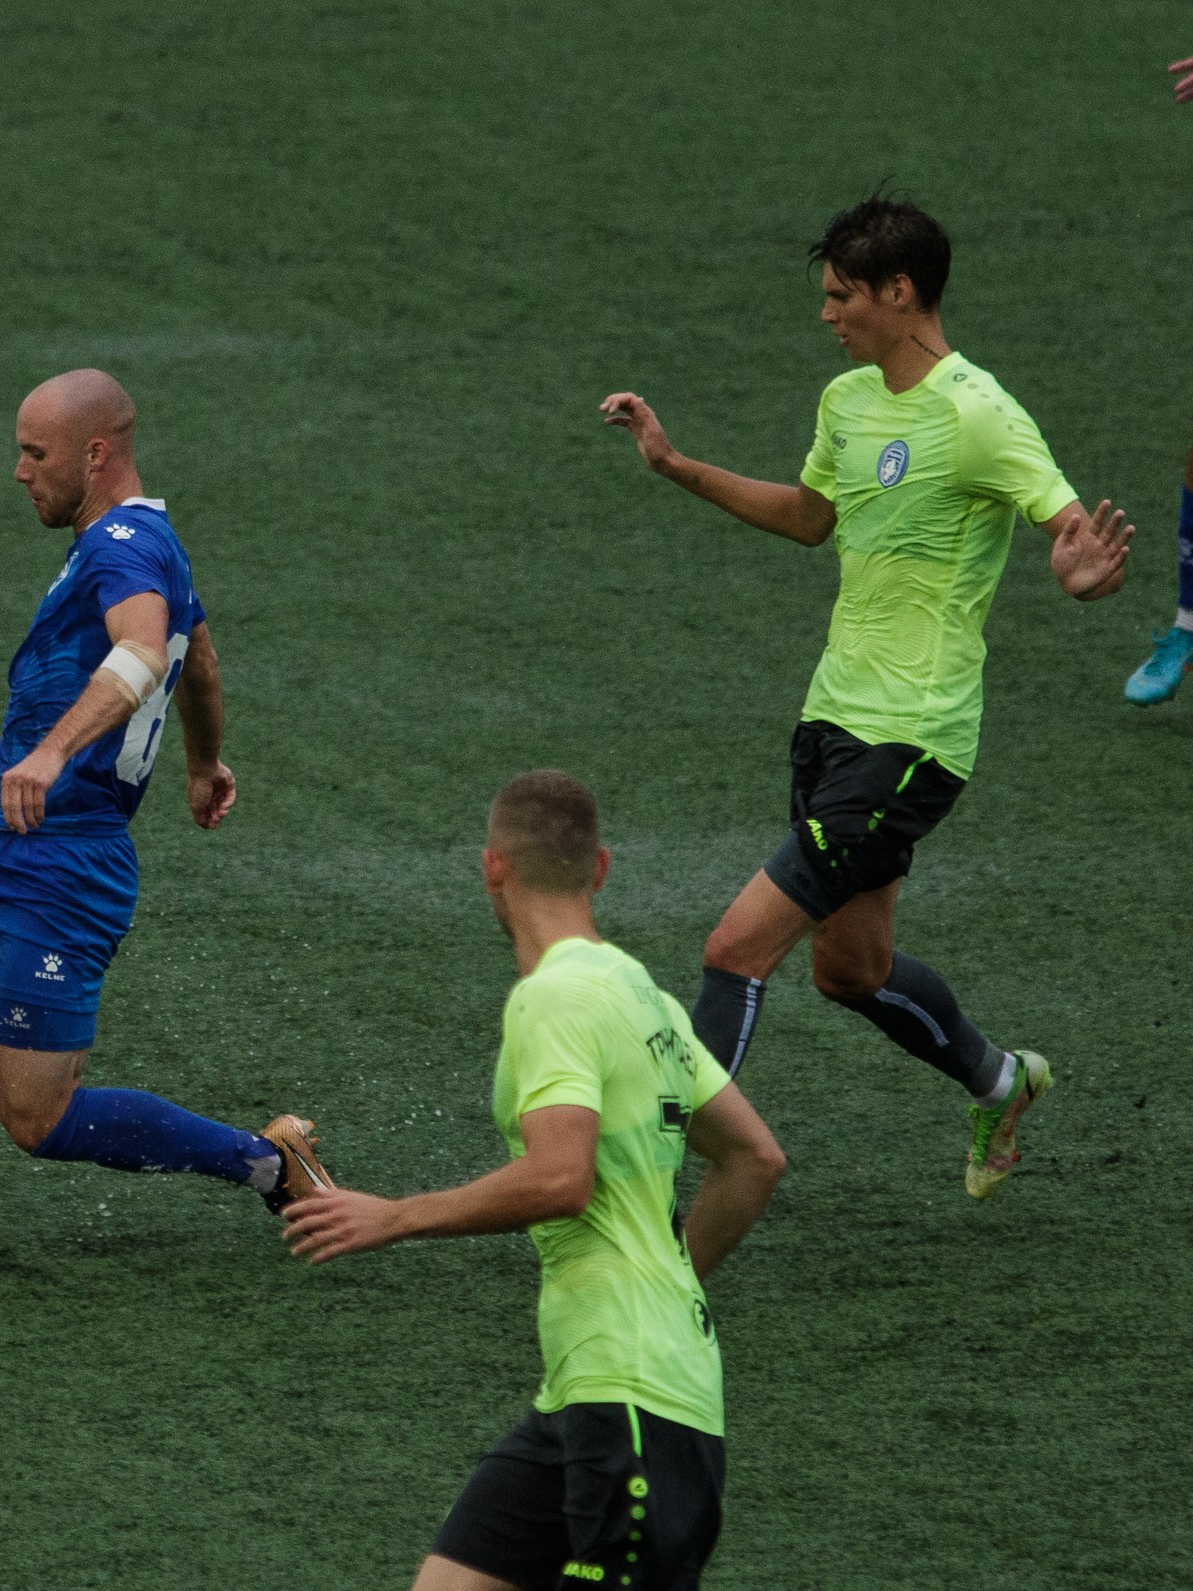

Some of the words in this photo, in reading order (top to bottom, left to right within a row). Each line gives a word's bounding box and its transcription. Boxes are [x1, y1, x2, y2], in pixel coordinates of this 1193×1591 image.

[34, 970, 66, 982] KELME
[3, 1016, 31, 1030] KELME
[563, 1561, 605, 1582] JAKO
